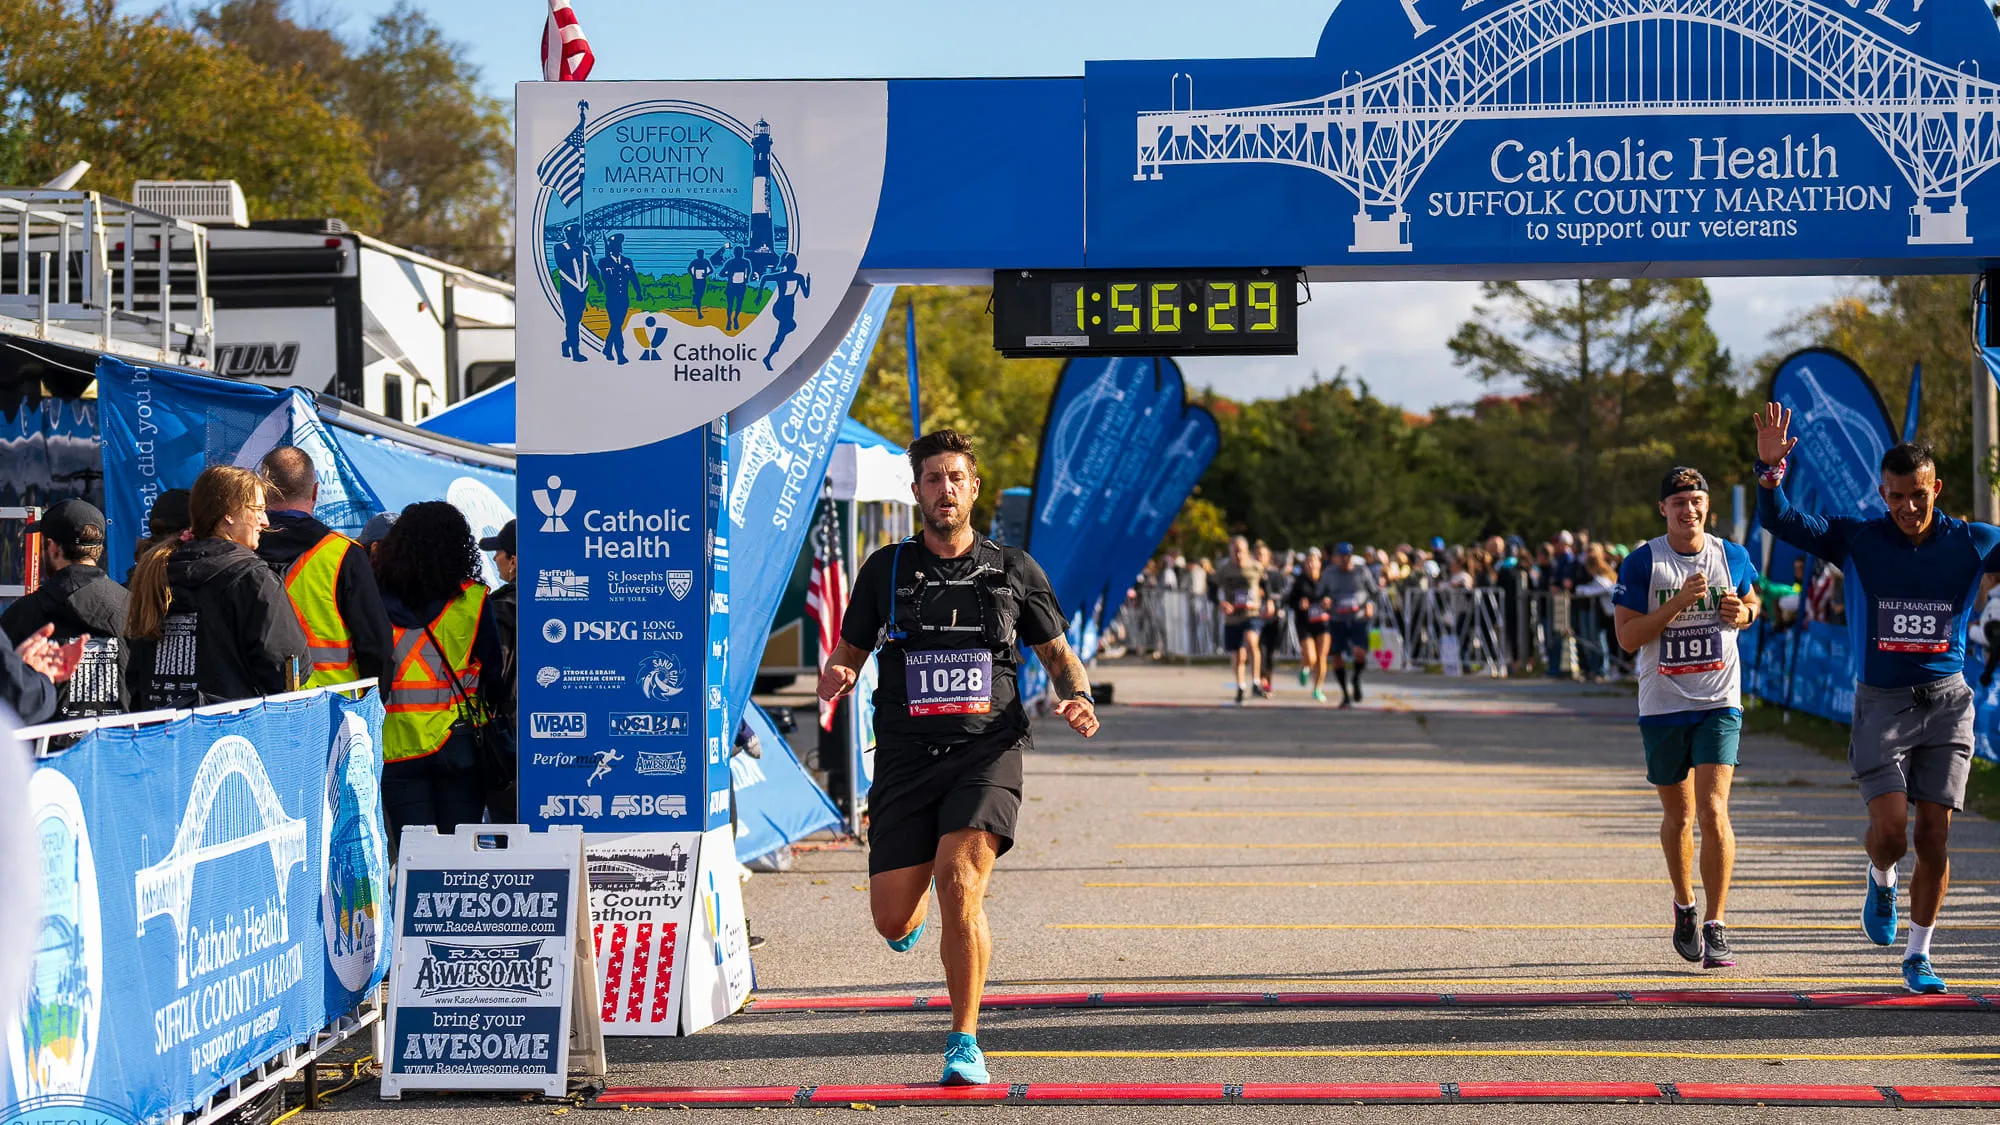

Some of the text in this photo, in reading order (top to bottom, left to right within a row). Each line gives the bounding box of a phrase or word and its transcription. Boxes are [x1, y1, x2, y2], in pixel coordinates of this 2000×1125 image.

[615, 126, 713, 143] SUFFOLK
[619, 146, 709, 163] COUNTY
[1491, 133, 1838, 184] Catholic Health
[604, 166, 724, 183] MARATHON
[1428, 185, 1892, 217] SUFFOLK COUNTY MARATHON
[1527, 218, 1798, 245] to support our veterans
[673, 343, 758, 362] Catholic
[840, 368, 856, 393] our
[848, 313, 874, 368] veterans
[673, 364, 742, 382] Health
[136, 390, 159, 435] you
[772, 346, 847, 531] SUFFOLK COUNTY
[135, 440, 156, 477] did
[583, 508, 690, 532] Catholic
[585, 536, 670, 558] Health
[608, 583, 666, 596] University
[1878, 601, 1952, 612] HALF MARATHON
[573, 621, 638, 641] PSEG
[642, 620, 676, 630] LONG
[1677, 625, 1720, 637] MARATHON
[1893, 614, 1937, 635] 833
[642, 631, 684, 641] ISLAND
[1666, 638, 1713, 659] 1191
[652, 658, 674, 670] SAND
[906, 652, 992, 666] HALF MARATHON
[668, 670, 678, 687] CITY
[919, 668, 983, 694] 1028
[533, 713, 584, 733] WBAB
[635, 757, 687, 771] AWESOME
[553, 795, 669, 817] STS SBC
[443, 871, 534, 889] bring your
[413, 892, 558, 919] AWESOME
[603, 893, 683, 910] County
[414, 921, 556, 933] www.RaceAwesome.com
[189, 895, 281, 980] Catholic Health
[448, 949, 520, 959] RACE
[413, 957, 553, 990] AWESOME
[202, 965, 262, 1030] COUNTY
[434, 995, 527, 1005] www.RaceAwesome.com
[433, 1012, 526, 1029] bring your
[201, 1025, 236, 1073] support
[236, 1021, 252, 1047] our
[402, 1033, 550, 1060] AWESOME
[404, 1063, 547, 1075] www.RaceAwesome.com
